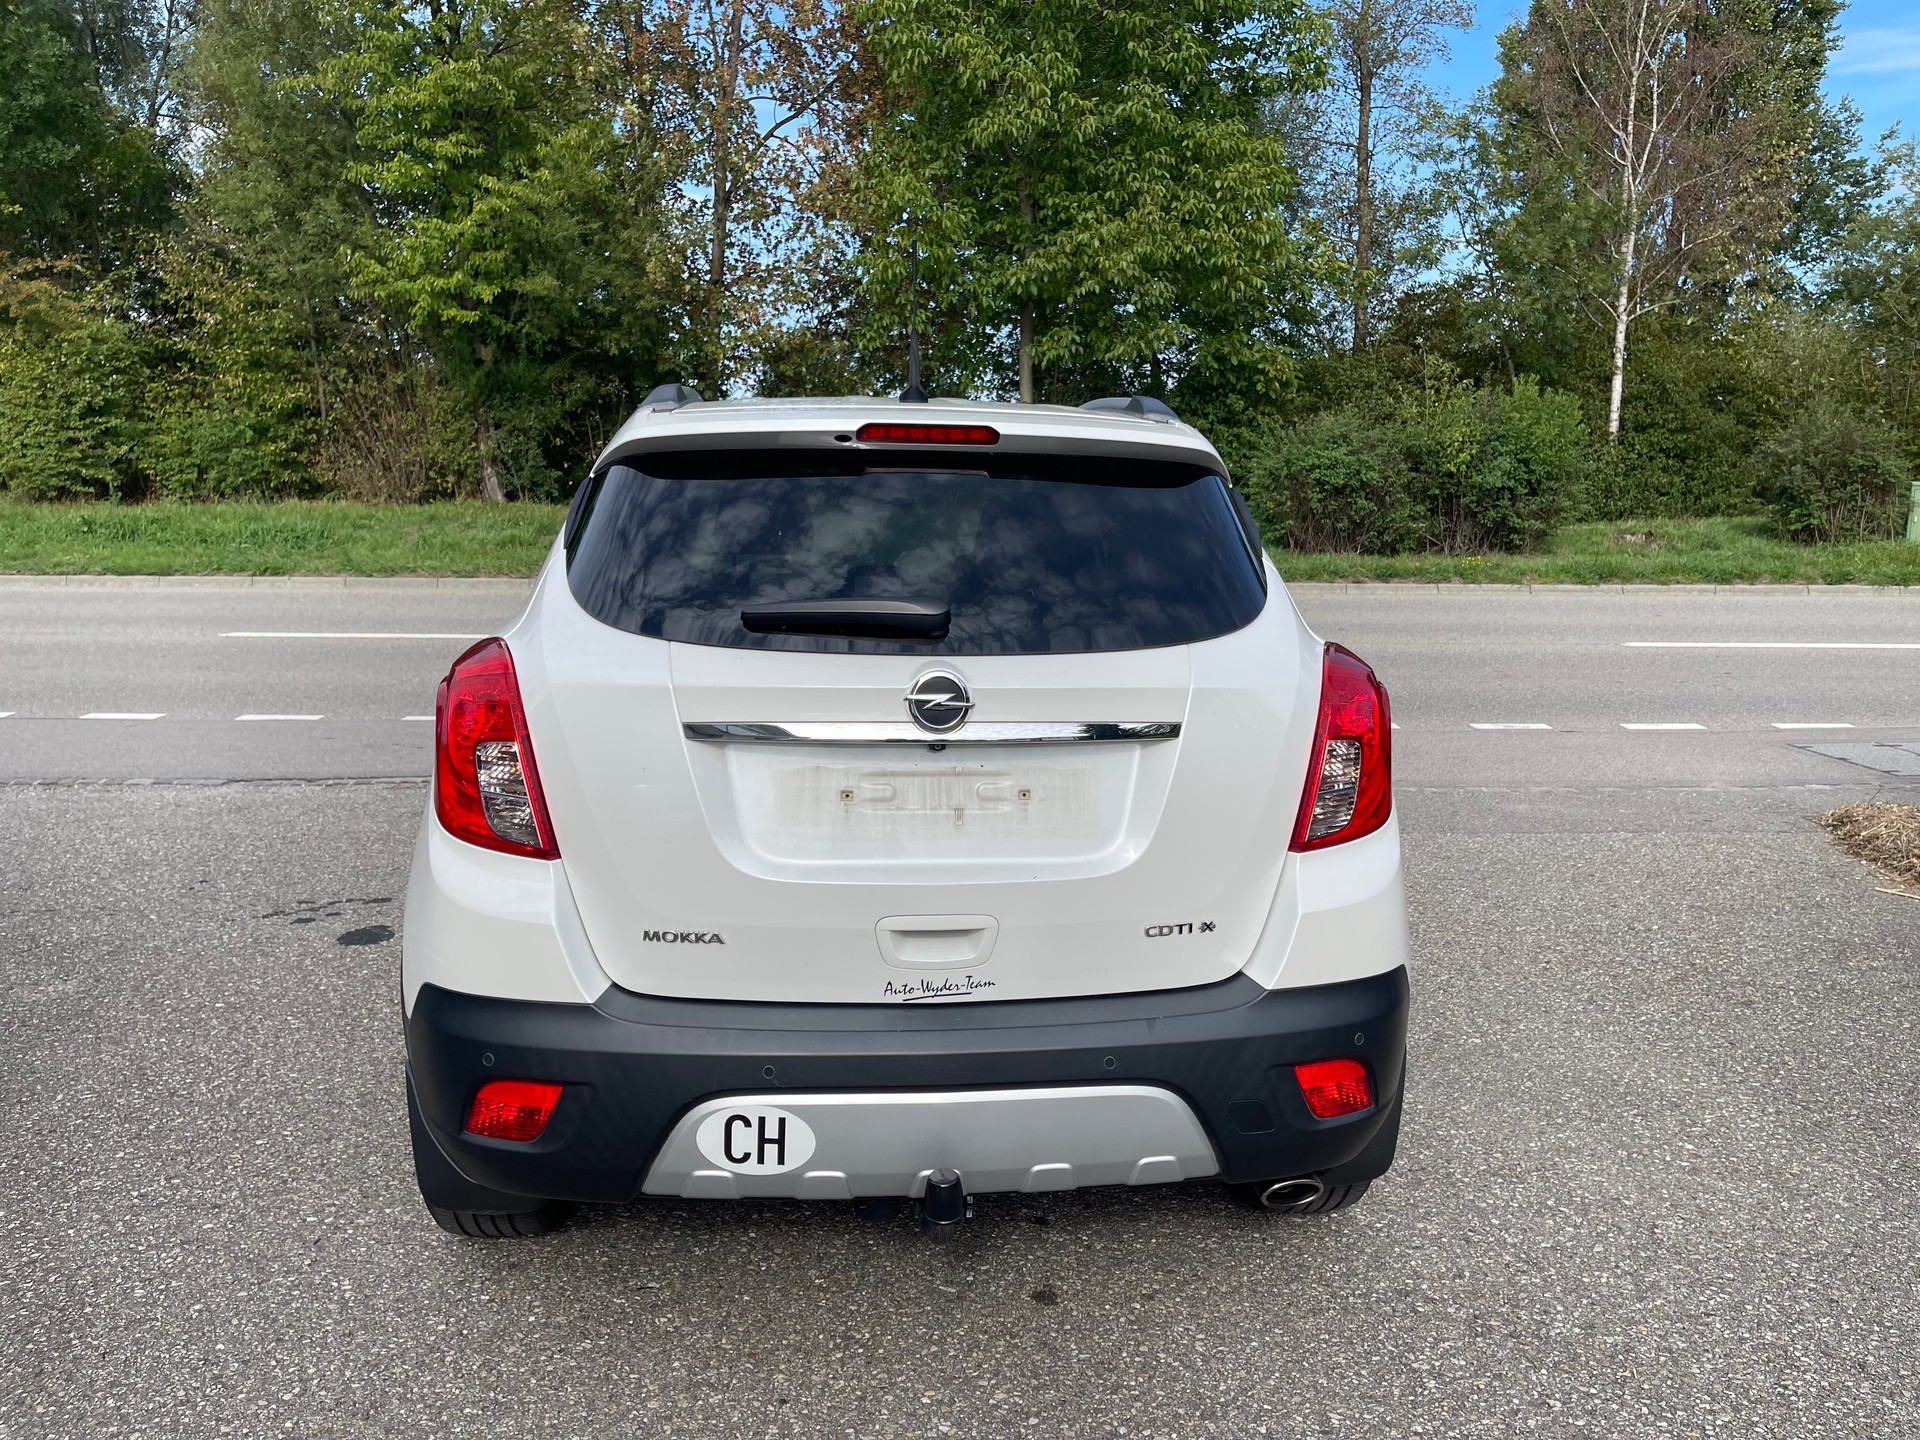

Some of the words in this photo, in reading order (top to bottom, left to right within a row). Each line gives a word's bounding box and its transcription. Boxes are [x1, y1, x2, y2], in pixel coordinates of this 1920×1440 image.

[642, 930, 726, 944] MOKKA
[1144, 922, 1193, 938] CDTI
[883, 975, 996, 999] Auto-Wyder-Team
[723, 1113, 786, 1165] CH
